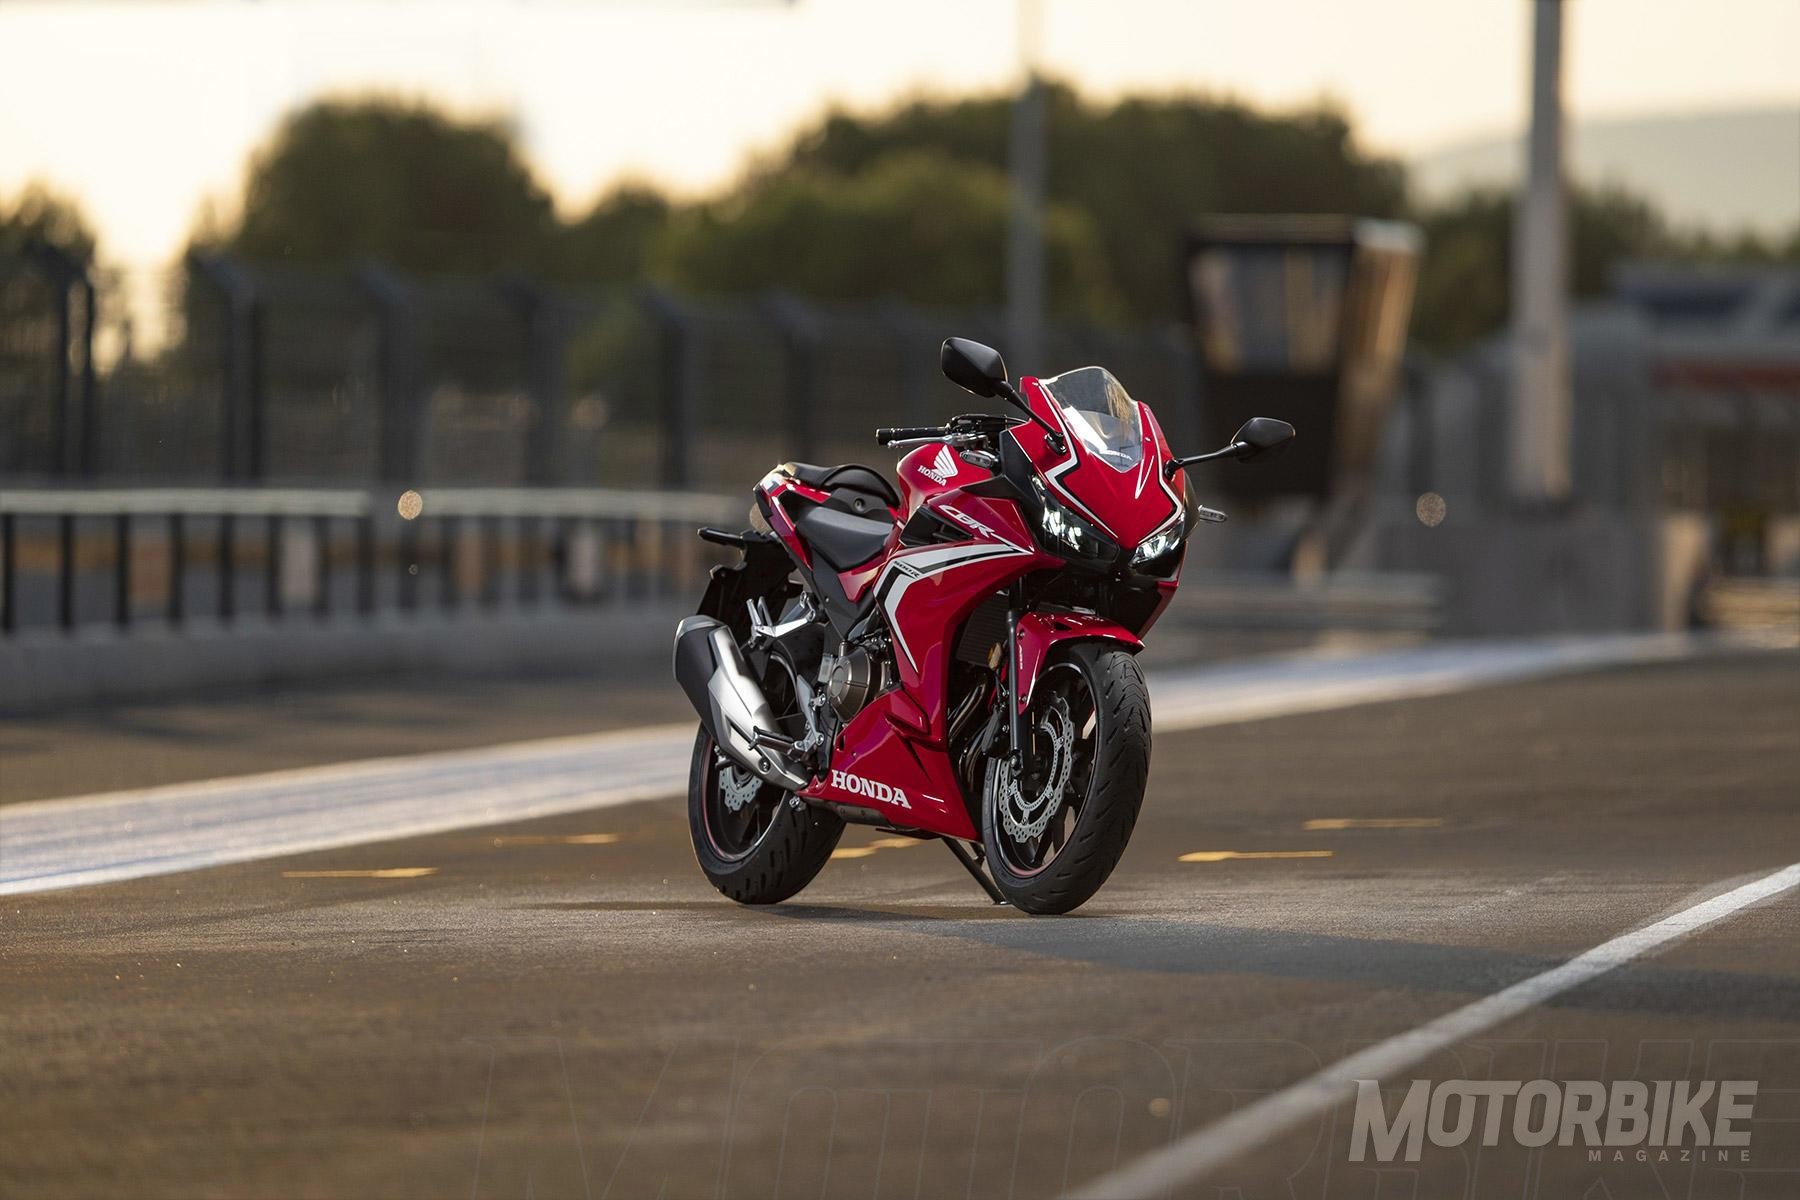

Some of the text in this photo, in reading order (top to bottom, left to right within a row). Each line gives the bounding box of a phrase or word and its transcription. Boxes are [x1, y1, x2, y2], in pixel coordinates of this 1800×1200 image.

[917, 465, 947, 487] HONDA
[938, 504, 996, 538] CBR
[831, 769, 912, 809] HONDA
